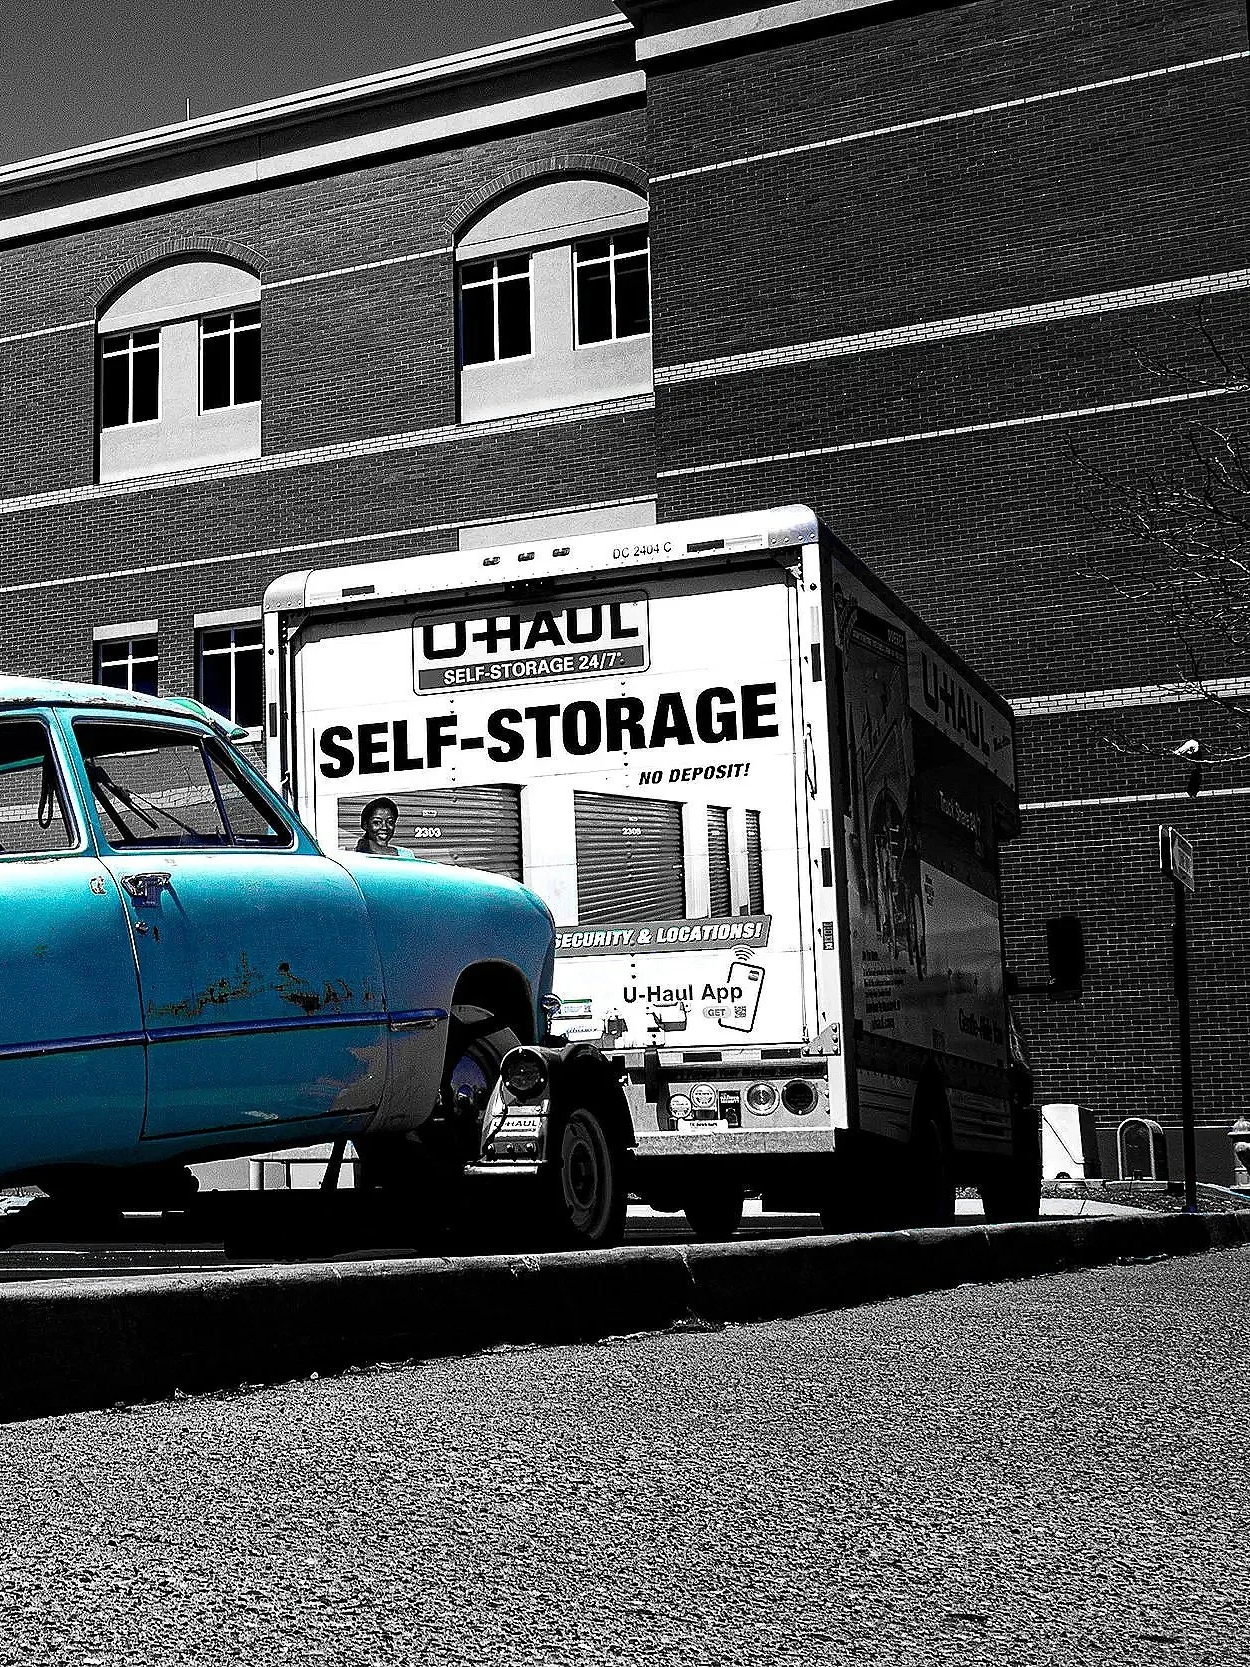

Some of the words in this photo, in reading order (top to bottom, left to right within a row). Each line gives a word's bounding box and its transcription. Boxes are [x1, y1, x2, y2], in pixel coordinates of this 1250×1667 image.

[613, 547, 630, 559] DC
[633, 544, 660, 557] 2404
[663, 542, 672, 553] C
[423, 602, 639, 660] U-HAUL
[443, 656, 574, 685] SELF-STORAGE
[921, 651, 990, 756] U-HAUL
[319, 682, 779, 779] SELF-STORAGE
[639, 771, 664, 786] NO
[669, 763, 751, 783] DEPOSIT!
[414, 827, 442, 838] 2303
[636, 928, 652, 944] &
[658, 922, 763, 943] LOCATIONS!
[623, 984, 693, 1004] U-Haul
[701, 983, 743, 1004] App
[707, 1008, 725, 1017] GET
